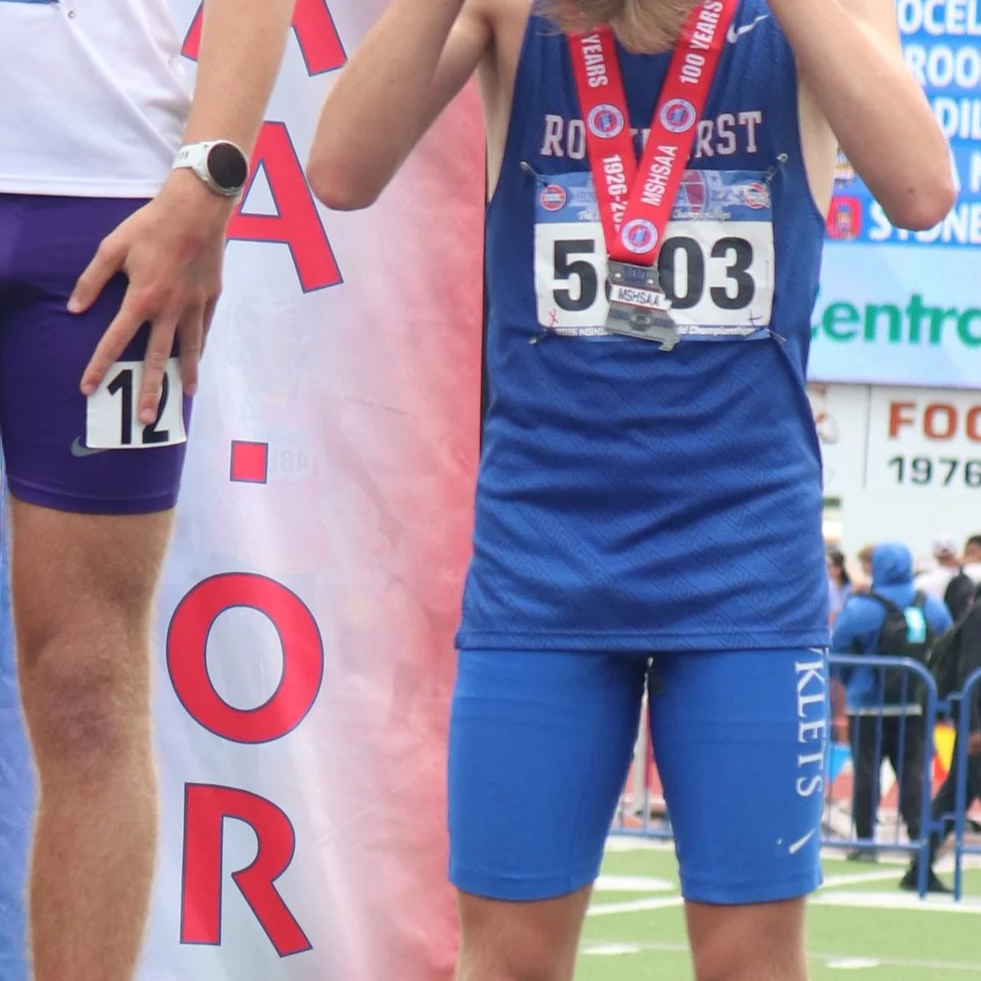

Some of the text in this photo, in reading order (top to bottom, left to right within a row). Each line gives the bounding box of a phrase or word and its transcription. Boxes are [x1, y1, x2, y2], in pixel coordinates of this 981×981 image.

[580, 33, 609, 89] YEARS
[678, 0, 724, 85] 100 YEARS
[640, 145, 679, 207] MSHSAA
[552, 235, 757, 312] 503
[617, 287, 661, 307] MSHSAA
[107, 369, 170, 445] 12
